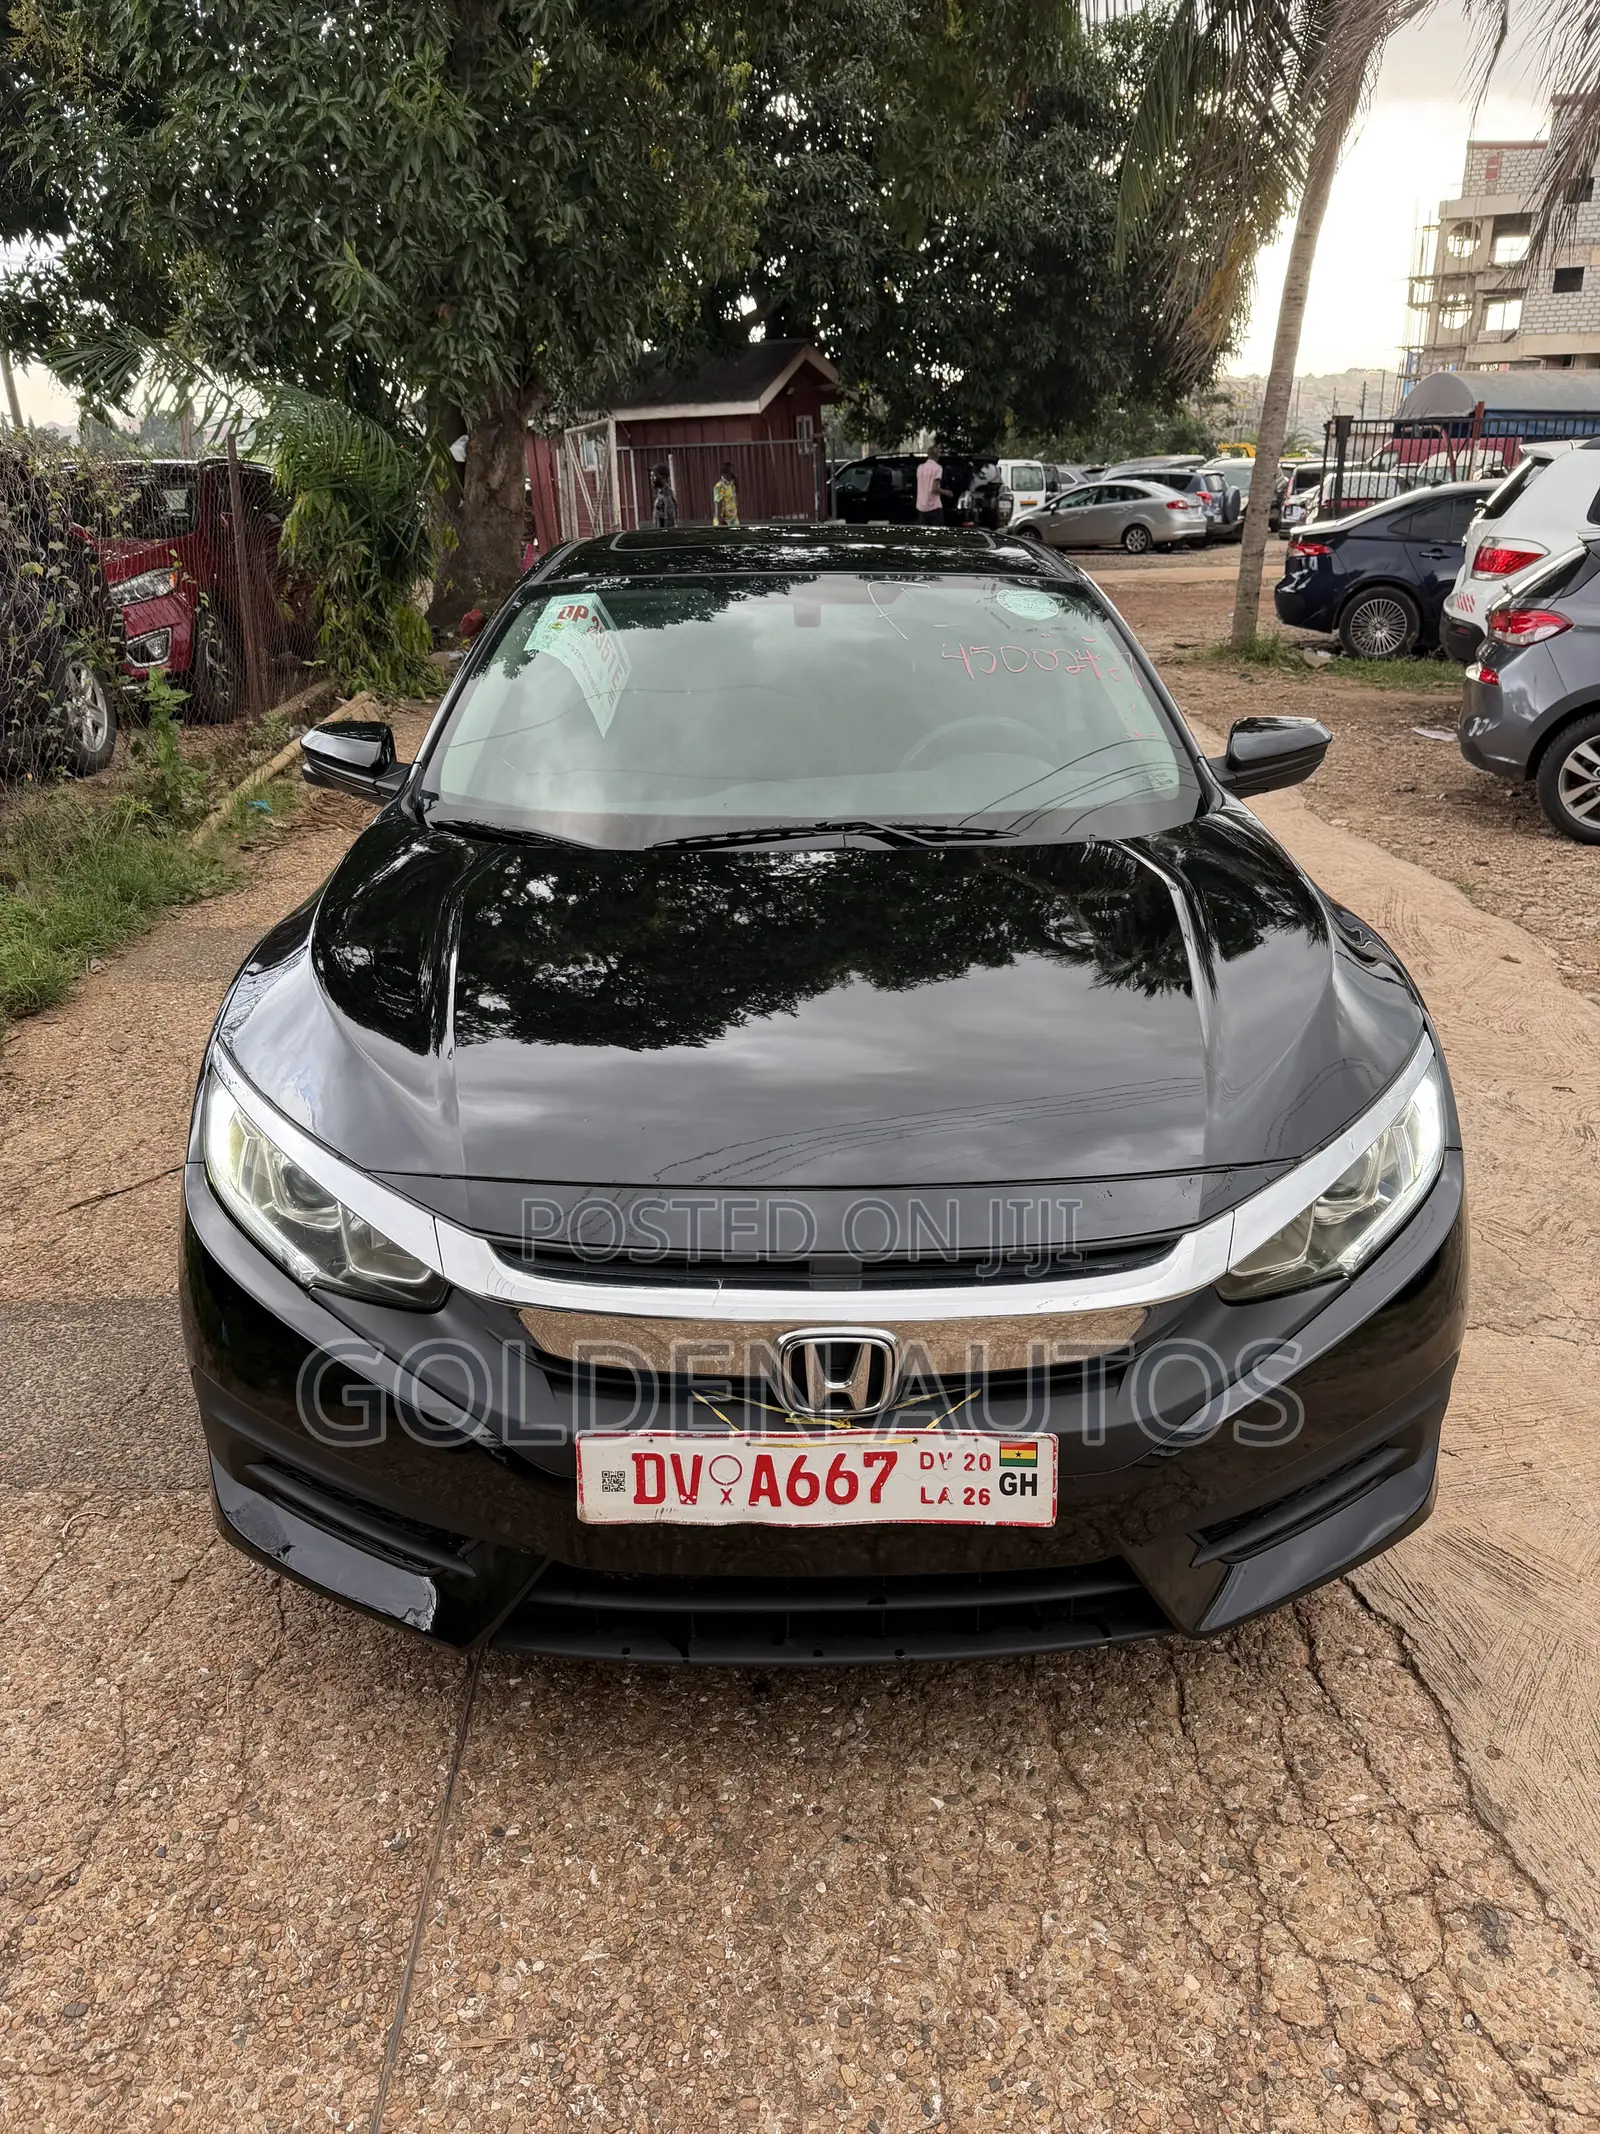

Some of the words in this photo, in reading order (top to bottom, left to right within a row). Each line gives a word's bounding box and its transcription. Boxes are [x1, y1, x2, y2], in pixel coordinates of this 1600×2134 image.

[919, 1451, 953, 1471] DV
[963, 1452, 992, 1472] 20
[631, 1452, 703, 1504] DV
[748, 1450, 898, 1507] A667
[999, 1471, 1038, 1497] GH
[920, 1485, 954, 1505] LA
[963, 1486, 992, 1506] 26
